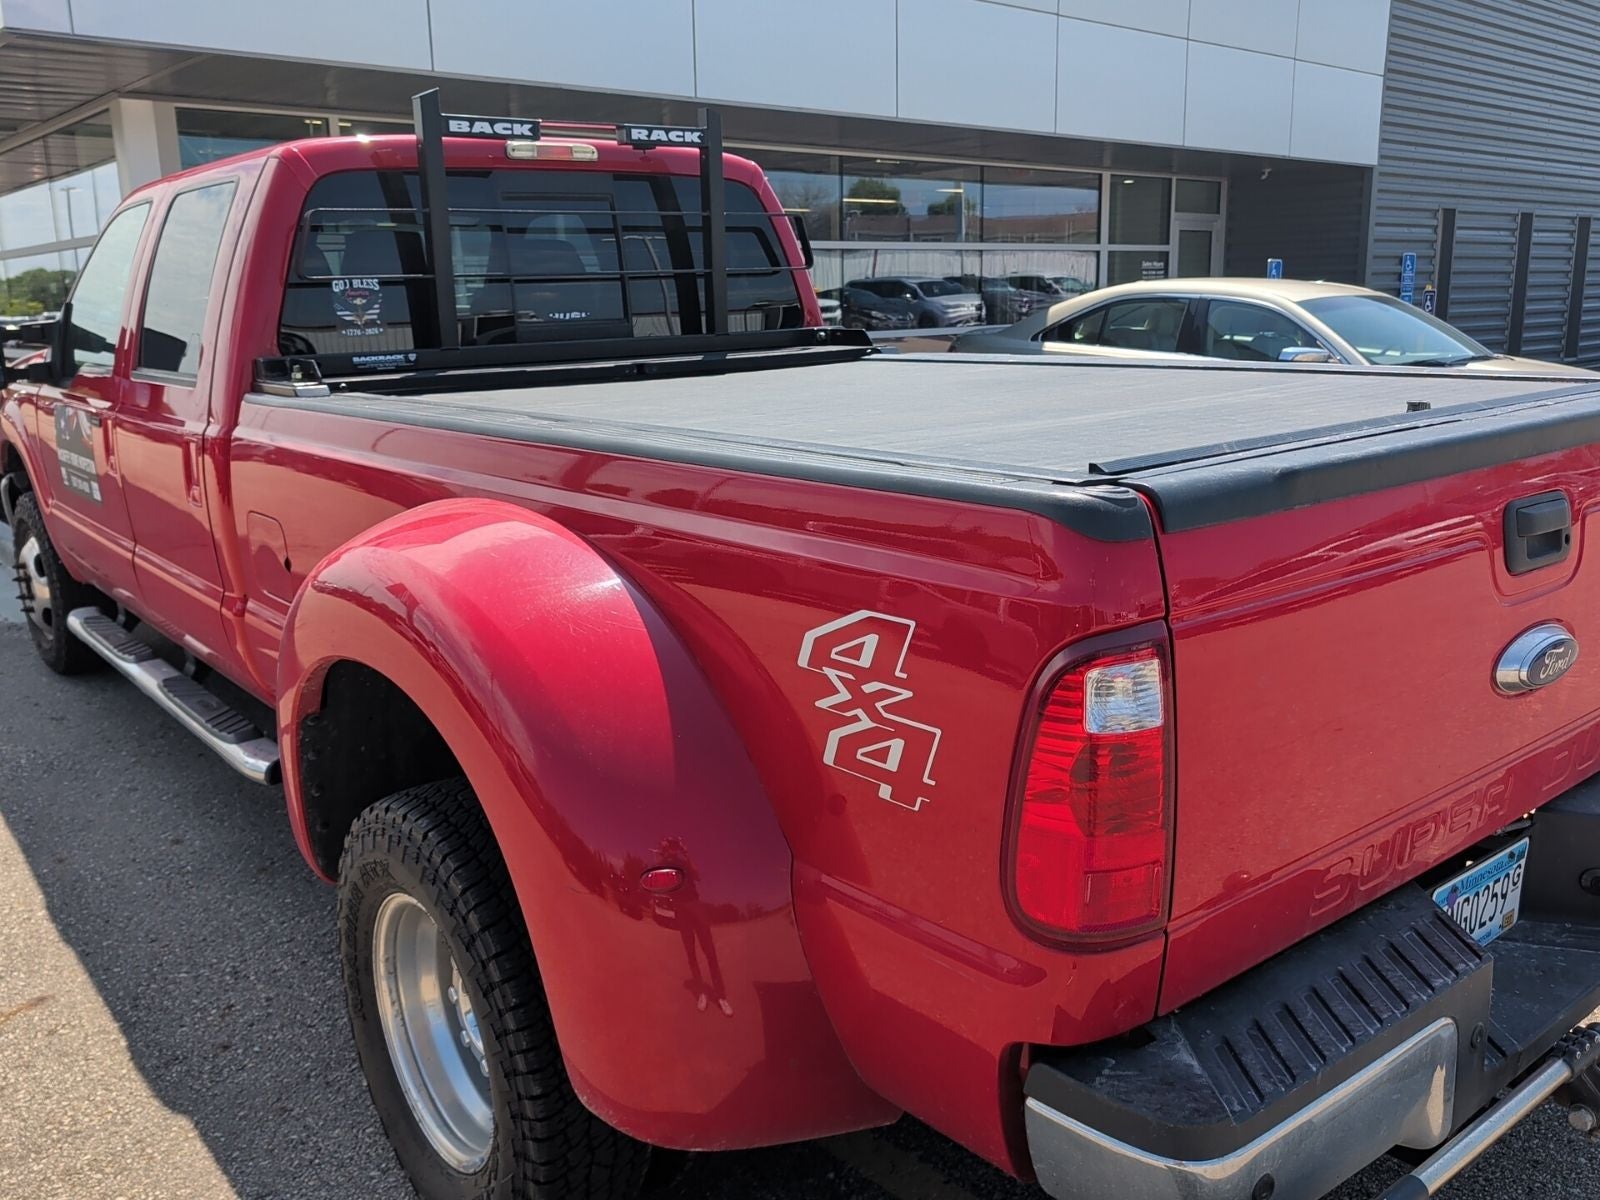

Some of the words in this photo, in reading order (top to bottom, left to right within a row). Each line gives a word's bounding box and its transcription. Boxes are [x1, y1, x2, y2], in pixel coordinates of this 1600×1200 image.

[449, 120, 534, 136] BACK
[631, 128, 703, 143] RACK
[352, 279, 380, 291] BLESS
[1540, 647, 1571, 679] Ford
[1308, 772, 1514, 917] SUPER
